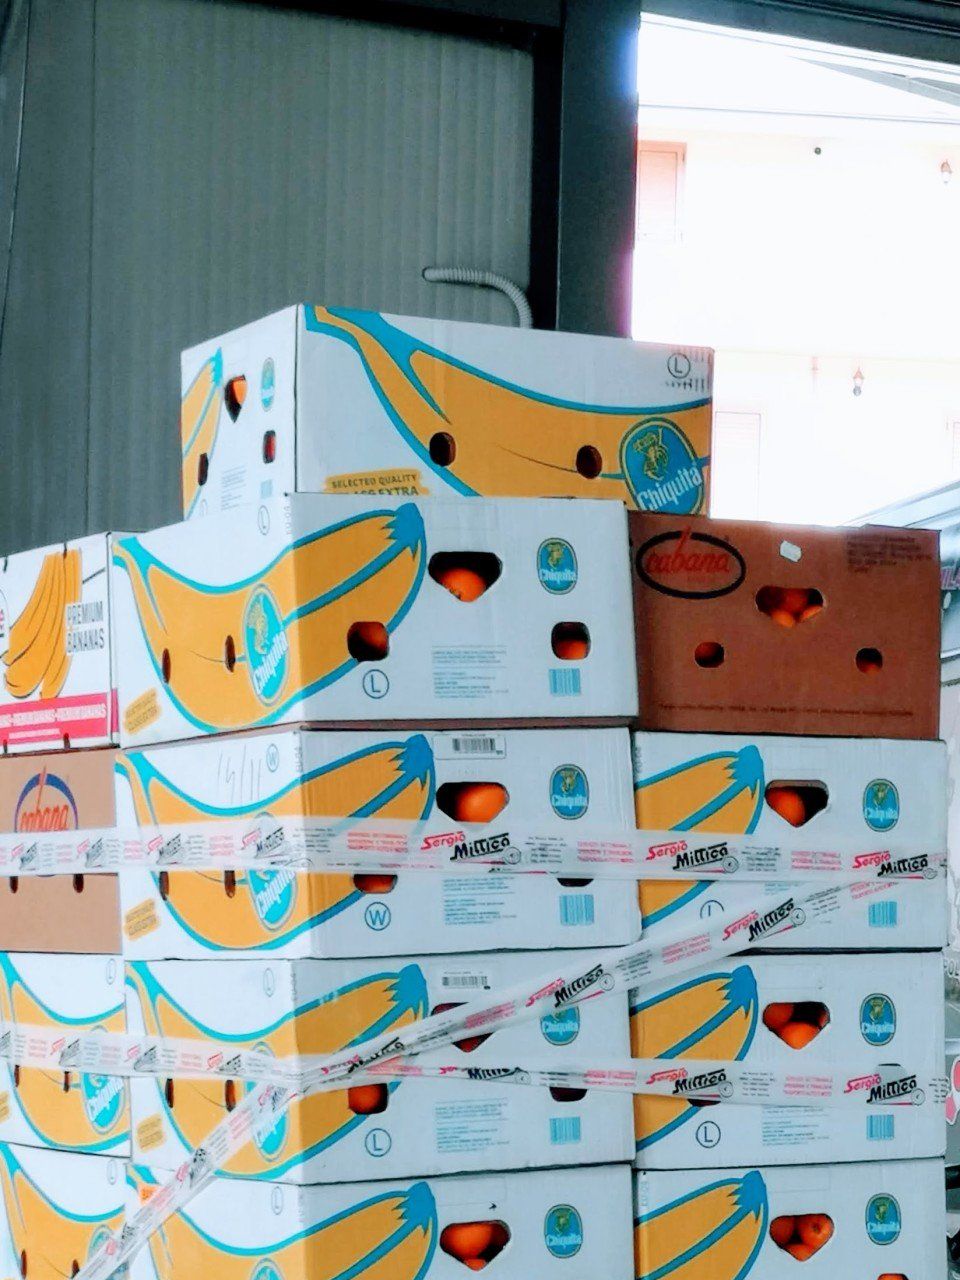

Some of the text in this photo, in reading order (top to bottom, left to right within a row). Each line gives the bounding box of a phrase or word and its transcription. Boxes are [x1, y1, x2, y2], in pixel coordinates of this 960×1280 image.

[332, 474, 417, 489] SELECTED QUALITY
[637, 464, 702, 512] Chiquita
[67, 601, 103, 625] PREMIUM
[67, 628, 104, 653] BANANAS
